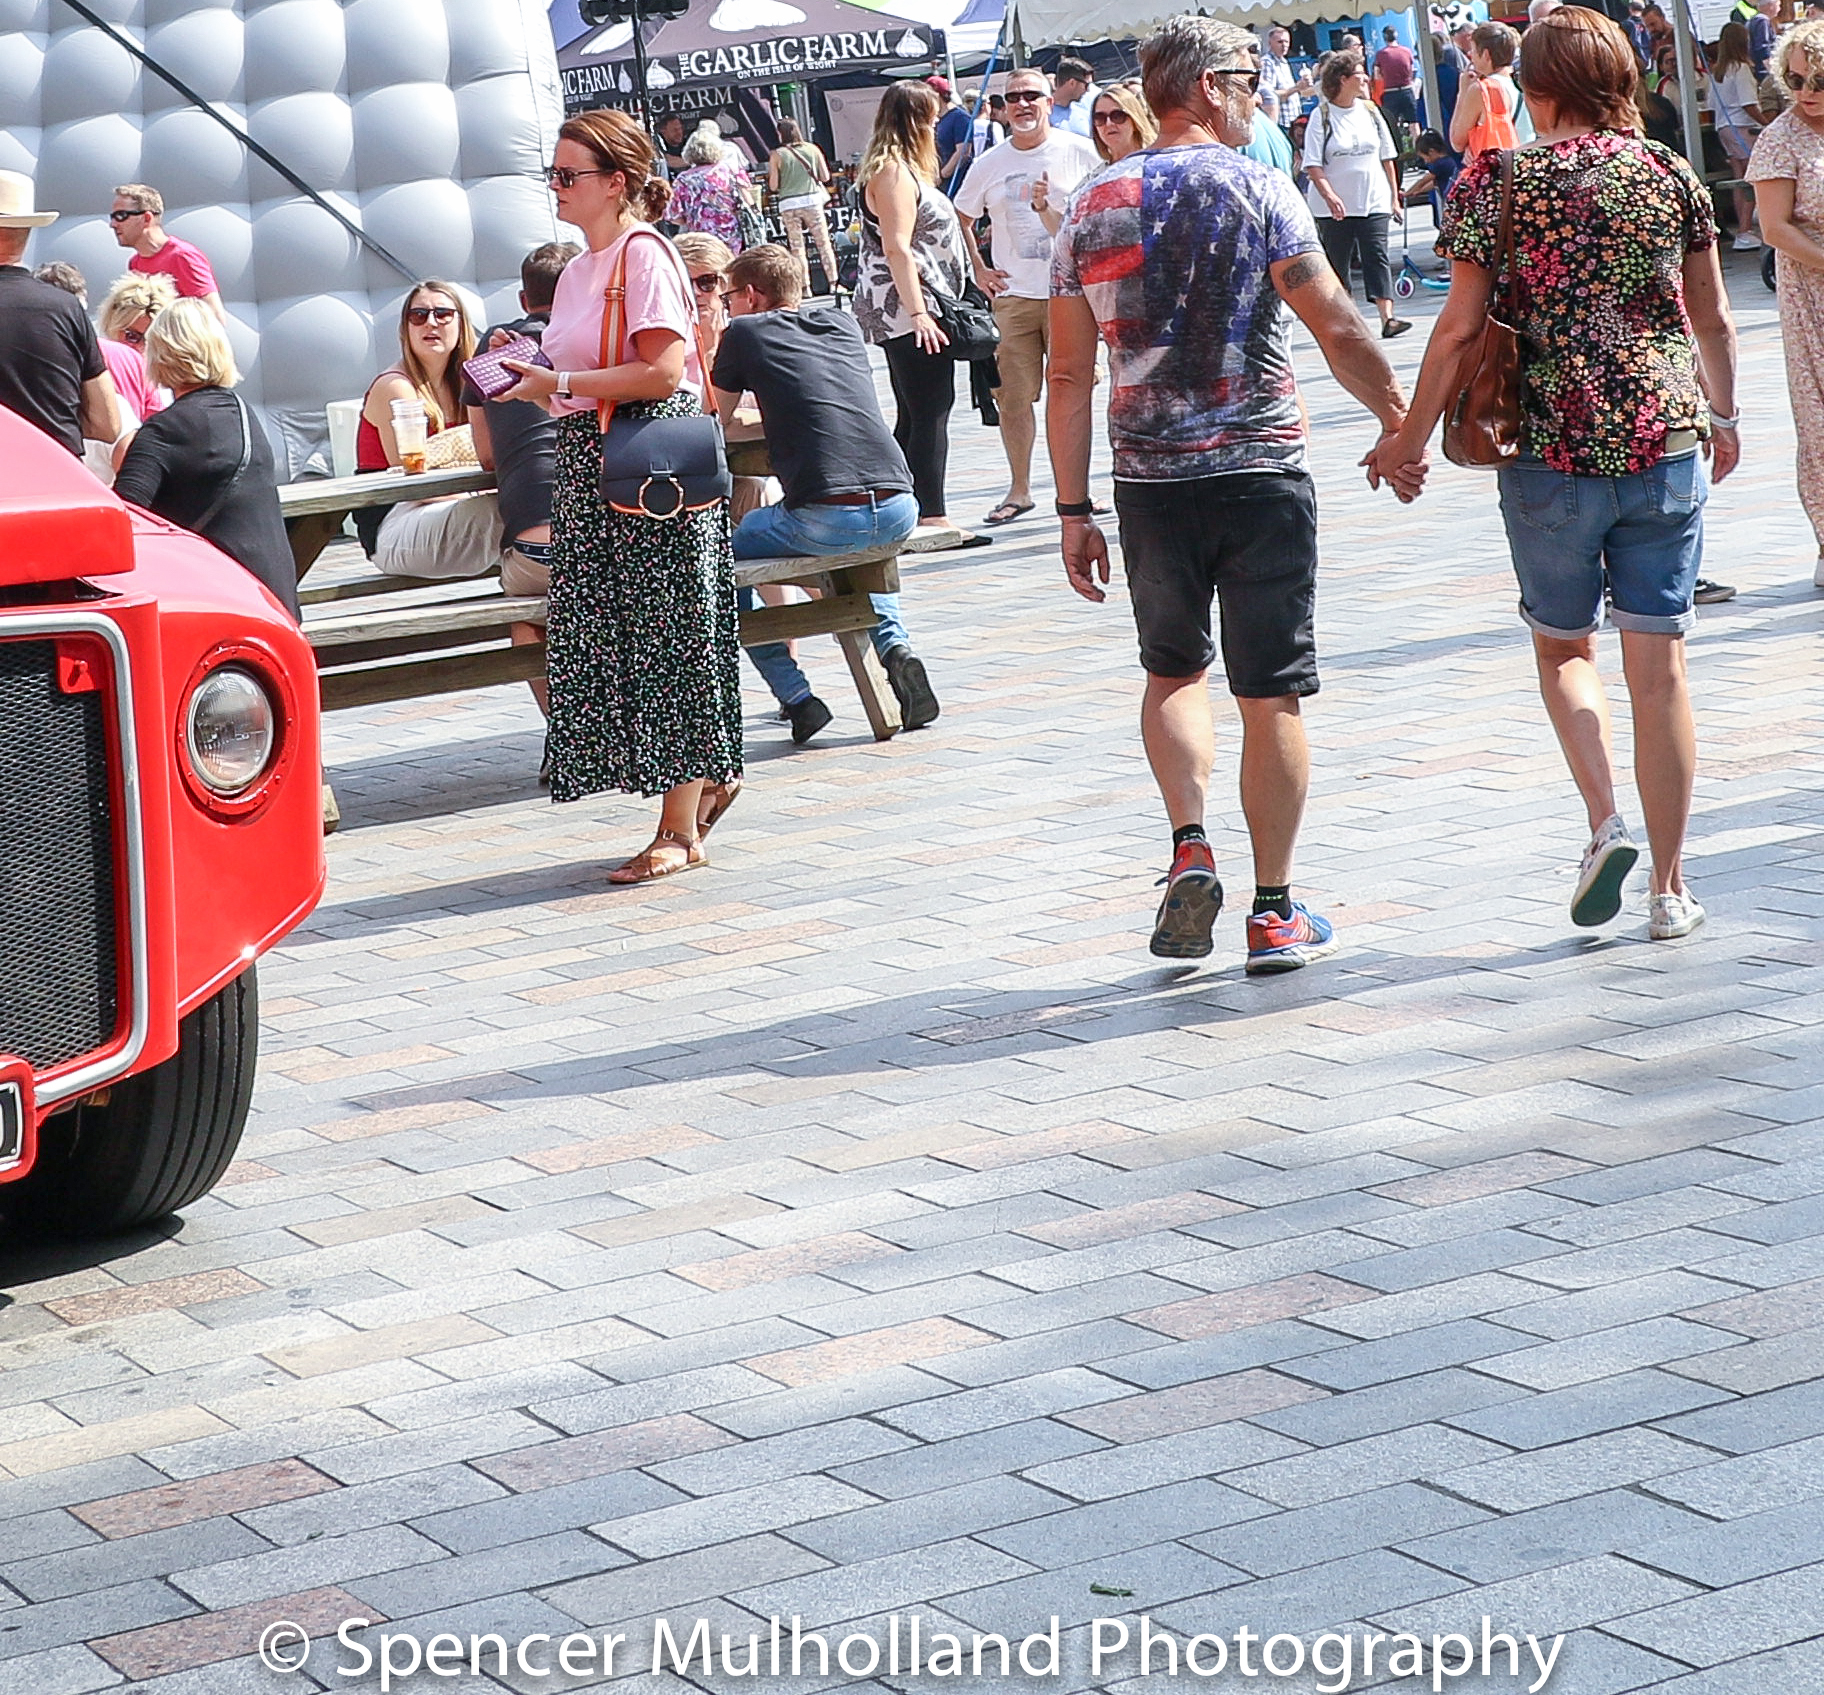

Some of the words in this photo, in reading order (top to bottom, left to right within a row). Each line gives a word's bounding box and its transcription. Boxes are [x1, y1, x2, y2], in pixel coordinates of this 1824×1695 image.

[679, 53, 691, 80] THE
[690, 37, 798, 77] GARLIC
[800, 30, 890, 64] FARM
[576, 64, 616, 94] FARM
[737, 70, 751, 80] ON
[753, 68, 771, 78] THE
[668, 85, 735, 112] FARM
